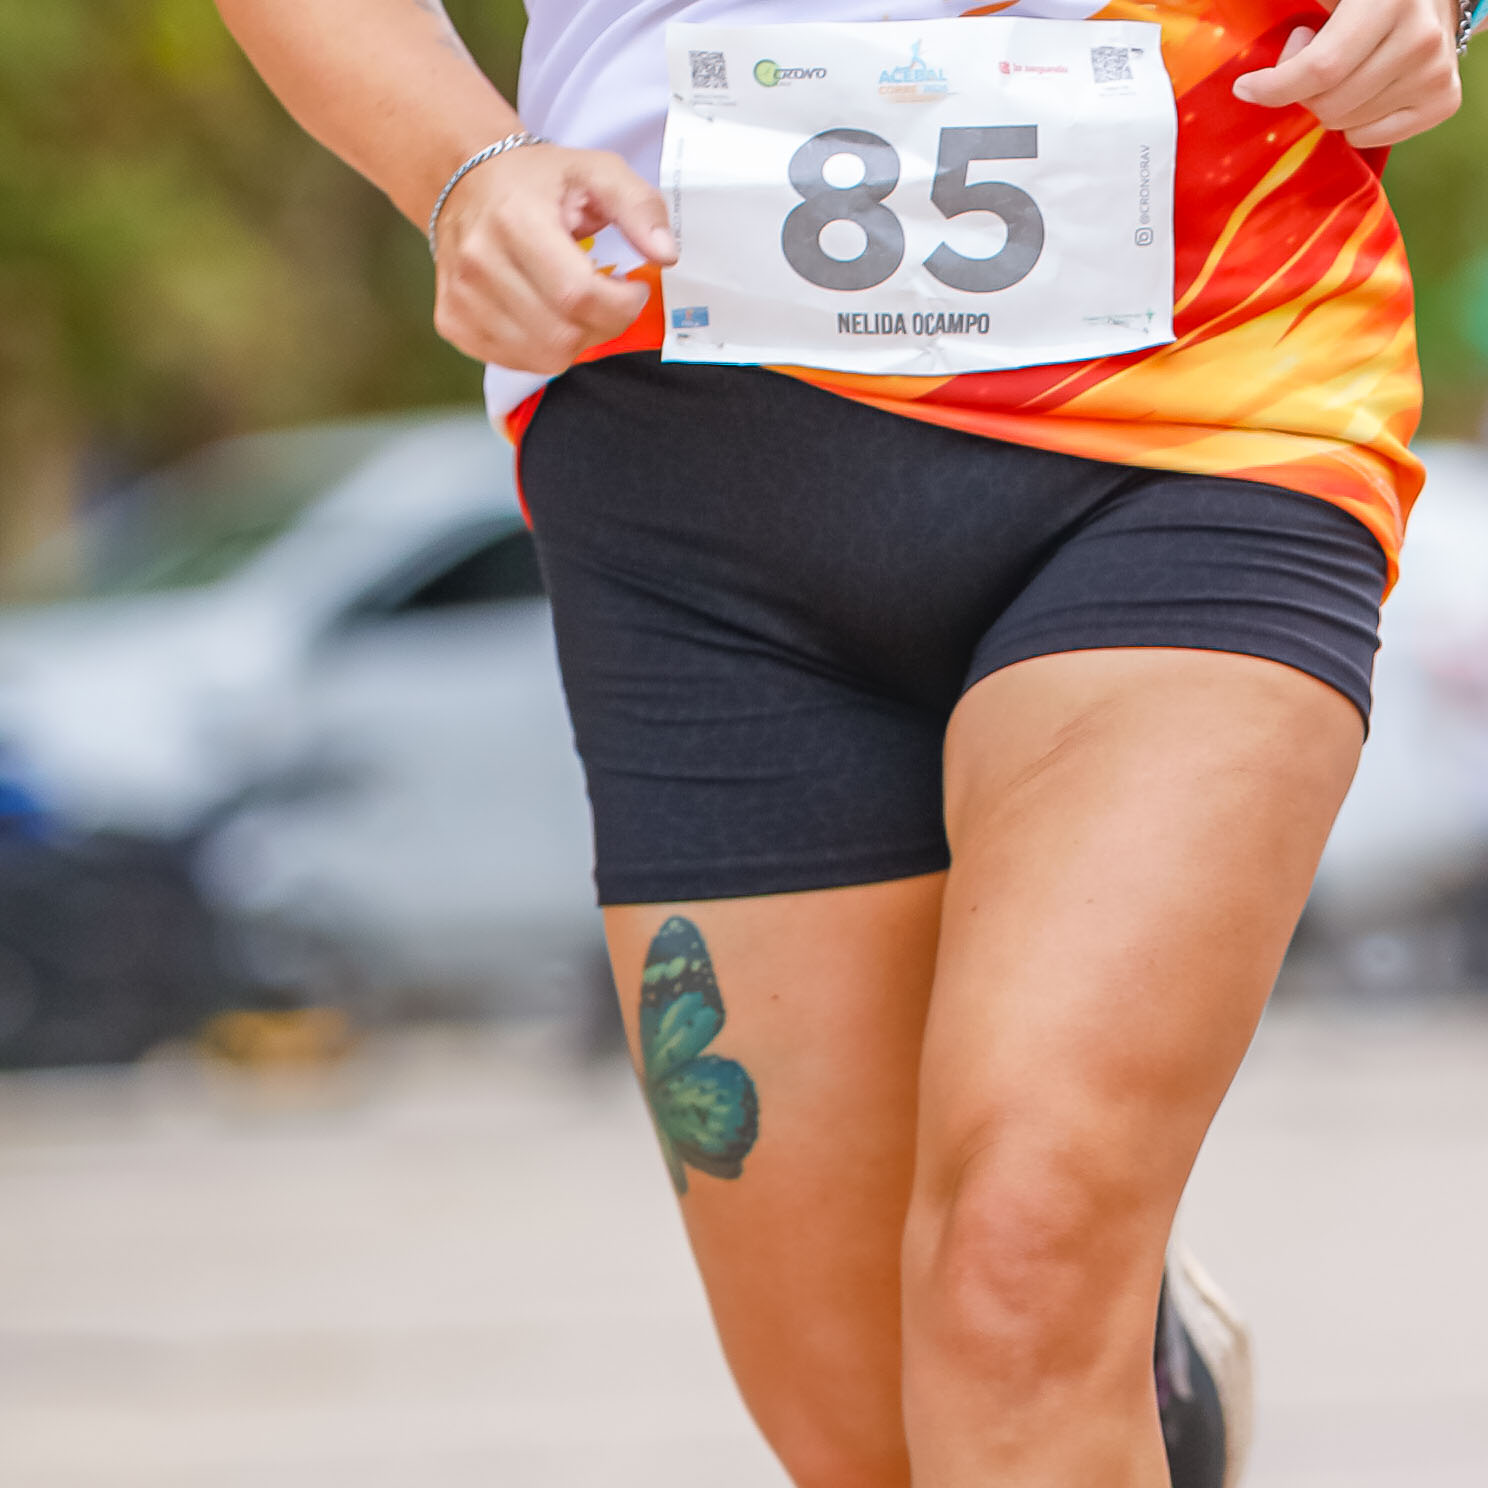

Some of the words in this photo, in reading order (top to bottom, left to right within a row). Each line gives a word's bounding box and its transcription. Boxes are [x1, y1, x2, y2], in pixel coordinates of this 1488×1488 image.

[781, 124, 1045, 293] 85
[837, 312, 907, 335] NELIDA
[912, 312, 990, 336] OCAMPO
